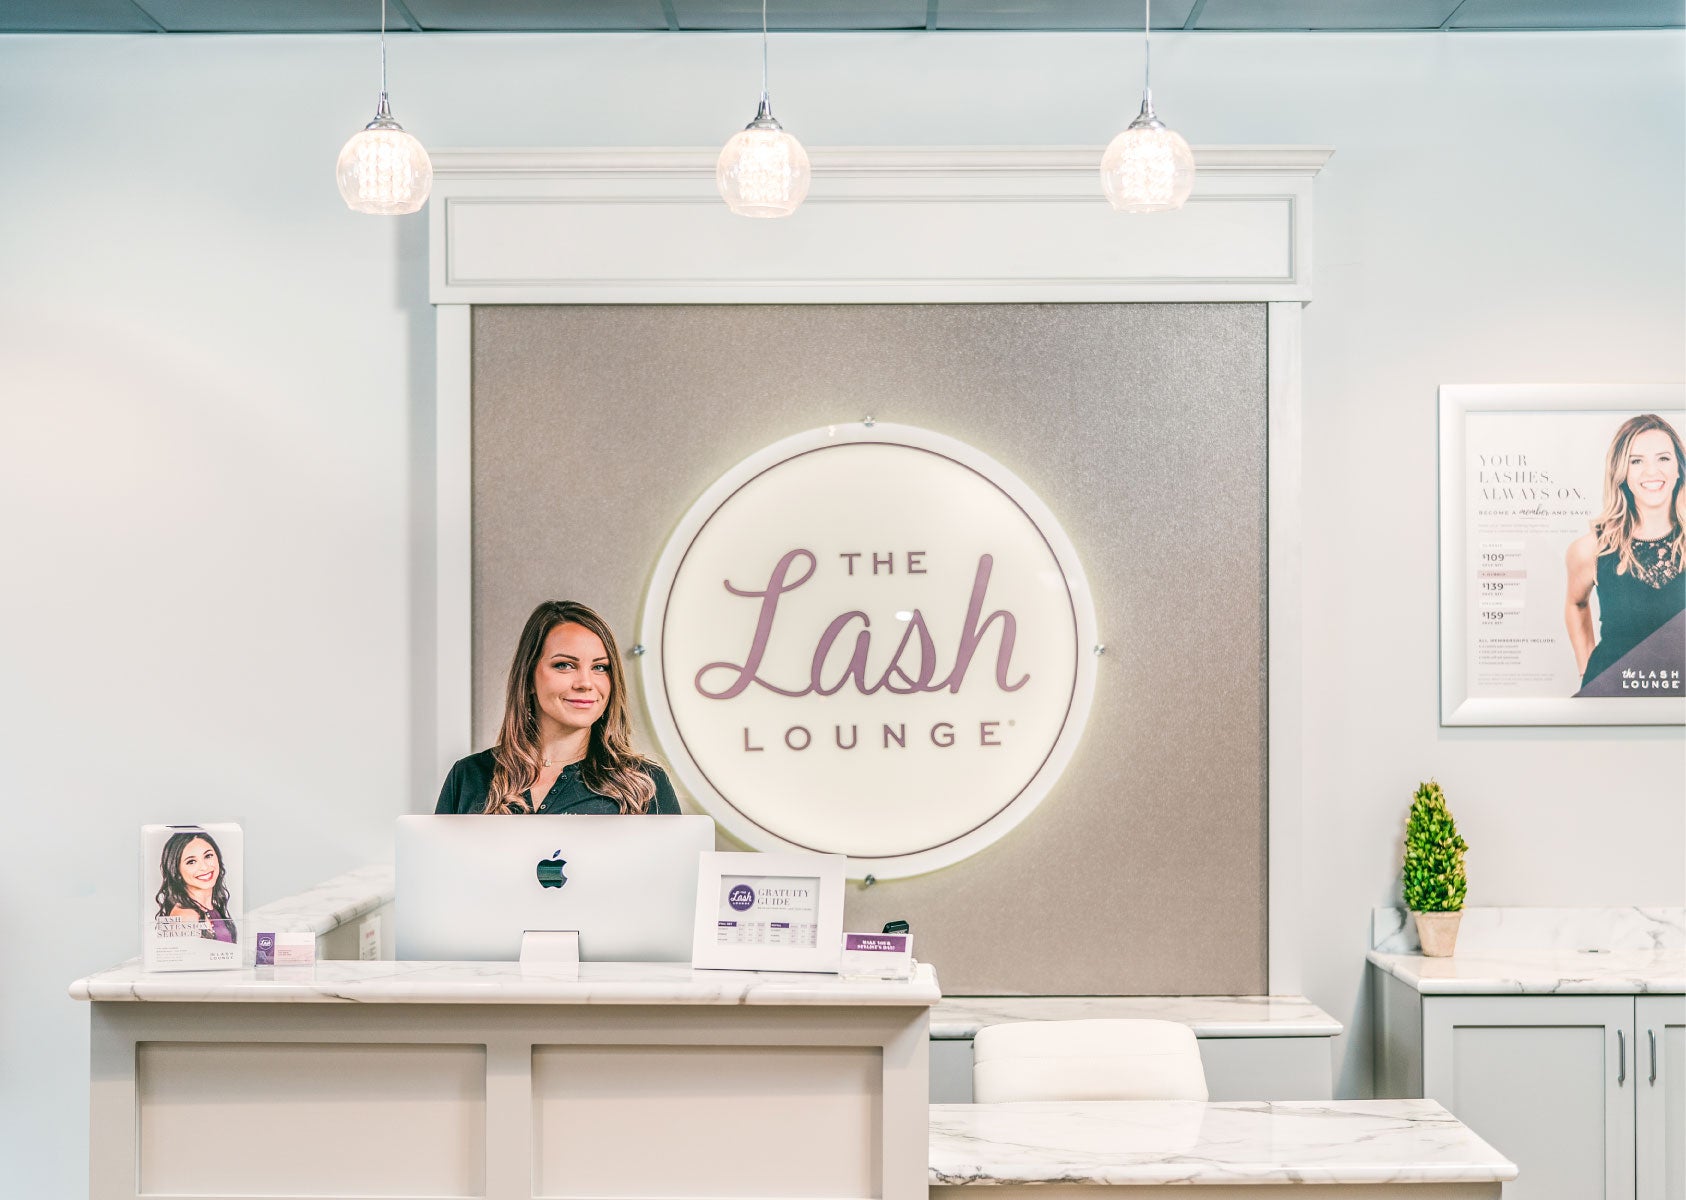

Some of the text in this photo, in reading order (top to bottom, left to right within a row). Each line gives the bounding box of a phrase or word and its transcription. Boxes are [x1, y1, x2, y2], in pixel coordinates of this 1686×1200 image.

[1479, 454, 1527, 466] YOUR
[1480, 488, 1586, 500] ALWAYS ON.
[1482, 553, 1505, 562] $109
[840, 551, 927, 577] THE
[1482, 582, 1504, 591] $139
[1482, 611, 1504, 620] $159
[694, 548, 1031, 700] Lash
[1638, 670, 1679, 679] LASH
[743, 721, 1003, 752] LOUNGE
[729, 890, 752, 902] Lash
[758, 888, 809, 898] GRATUITY
[757, 897, 790, 906] GUIDE
[157, 923, 208, 931] EXTENSION
[156, 930, 201, 938] SERVICES
